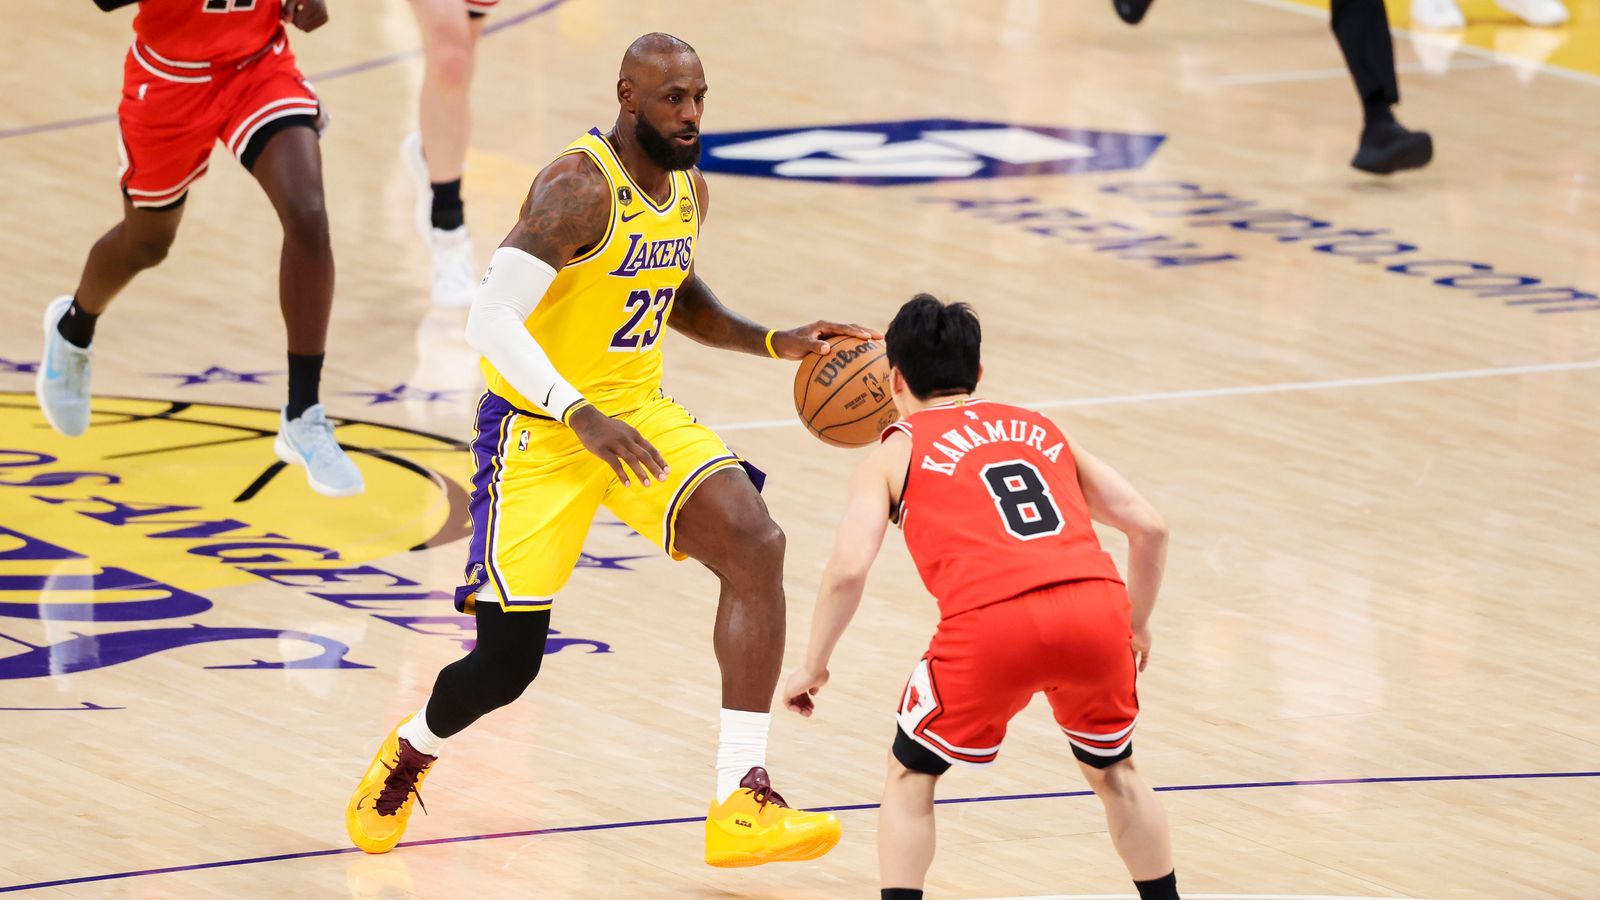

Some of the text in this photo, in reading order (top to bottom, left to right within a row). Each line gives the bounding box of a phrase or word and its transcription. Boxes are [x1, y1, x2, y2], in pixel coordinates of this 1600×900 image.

[608, 233, 693, 277] LAKERS
[1098, 181, 1600, 315] crypto.com
[608, 287, 675, 353] 23
[814, 341, 878, 388] Wilson
[921, 419, 1064, 476] KAWAMURA
[979, 458, 1066, 541] 8
